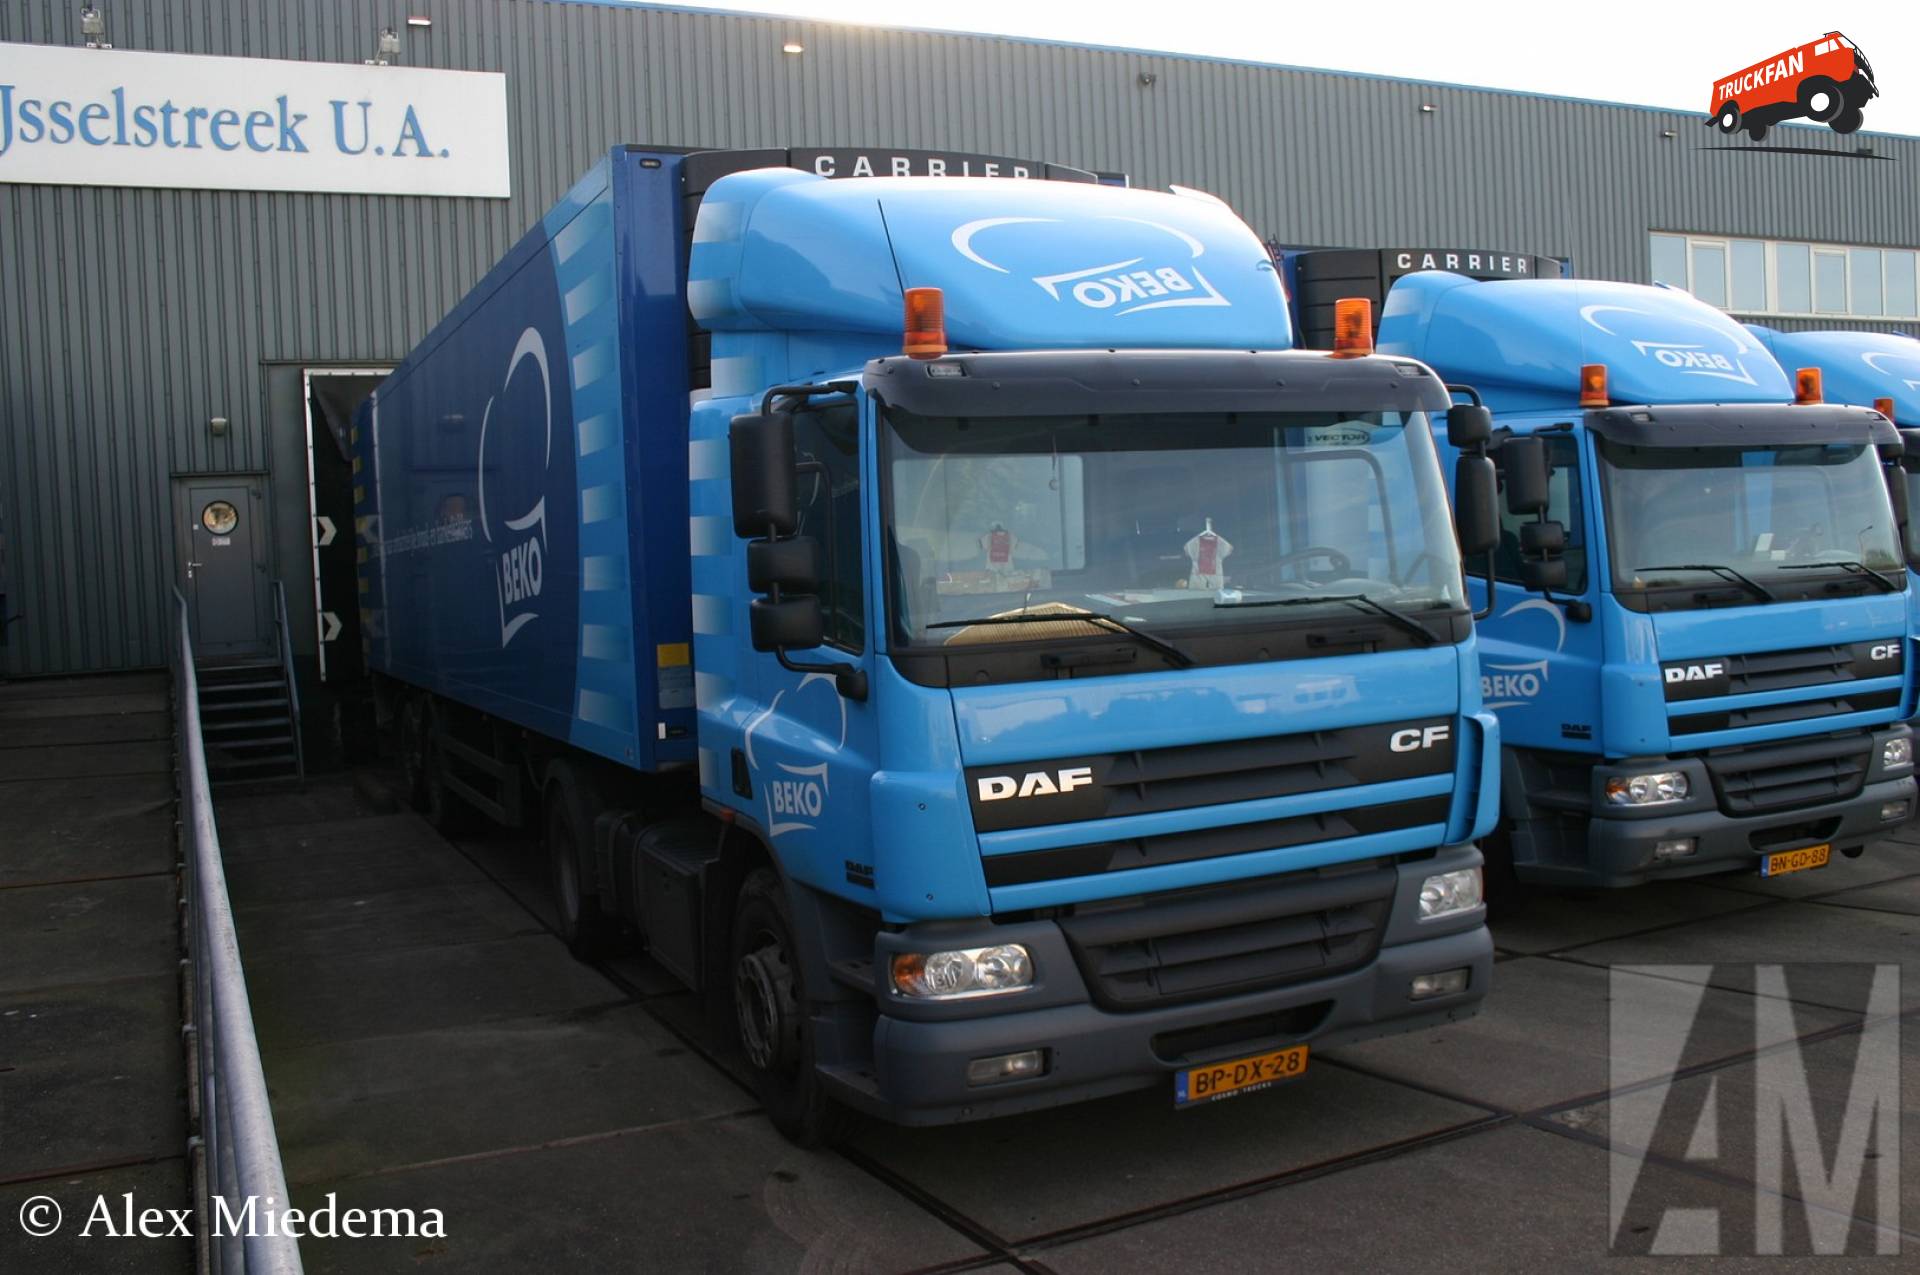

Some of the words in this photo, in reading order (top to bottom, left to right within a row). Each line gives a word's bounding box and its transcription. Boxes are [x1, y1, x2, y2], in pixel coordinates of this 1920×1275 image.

[329, 100, 450, 159] U.A.
[1397, 253, 1527, 274] CARRIER
[502, 536, 543, 605] BEKO
[1870, 644, 1901, 661] CF
[1480, 673, 1540, 697] BEKO
[1664, 663, 1723, 683] DAF
[1390, 725, 1450, 753] CF
[772, 780, 822, 817] BEKO
[978, 767, 1093, 801] DAF
[1196, 1051, 1300, 1094] BP-DX-28
